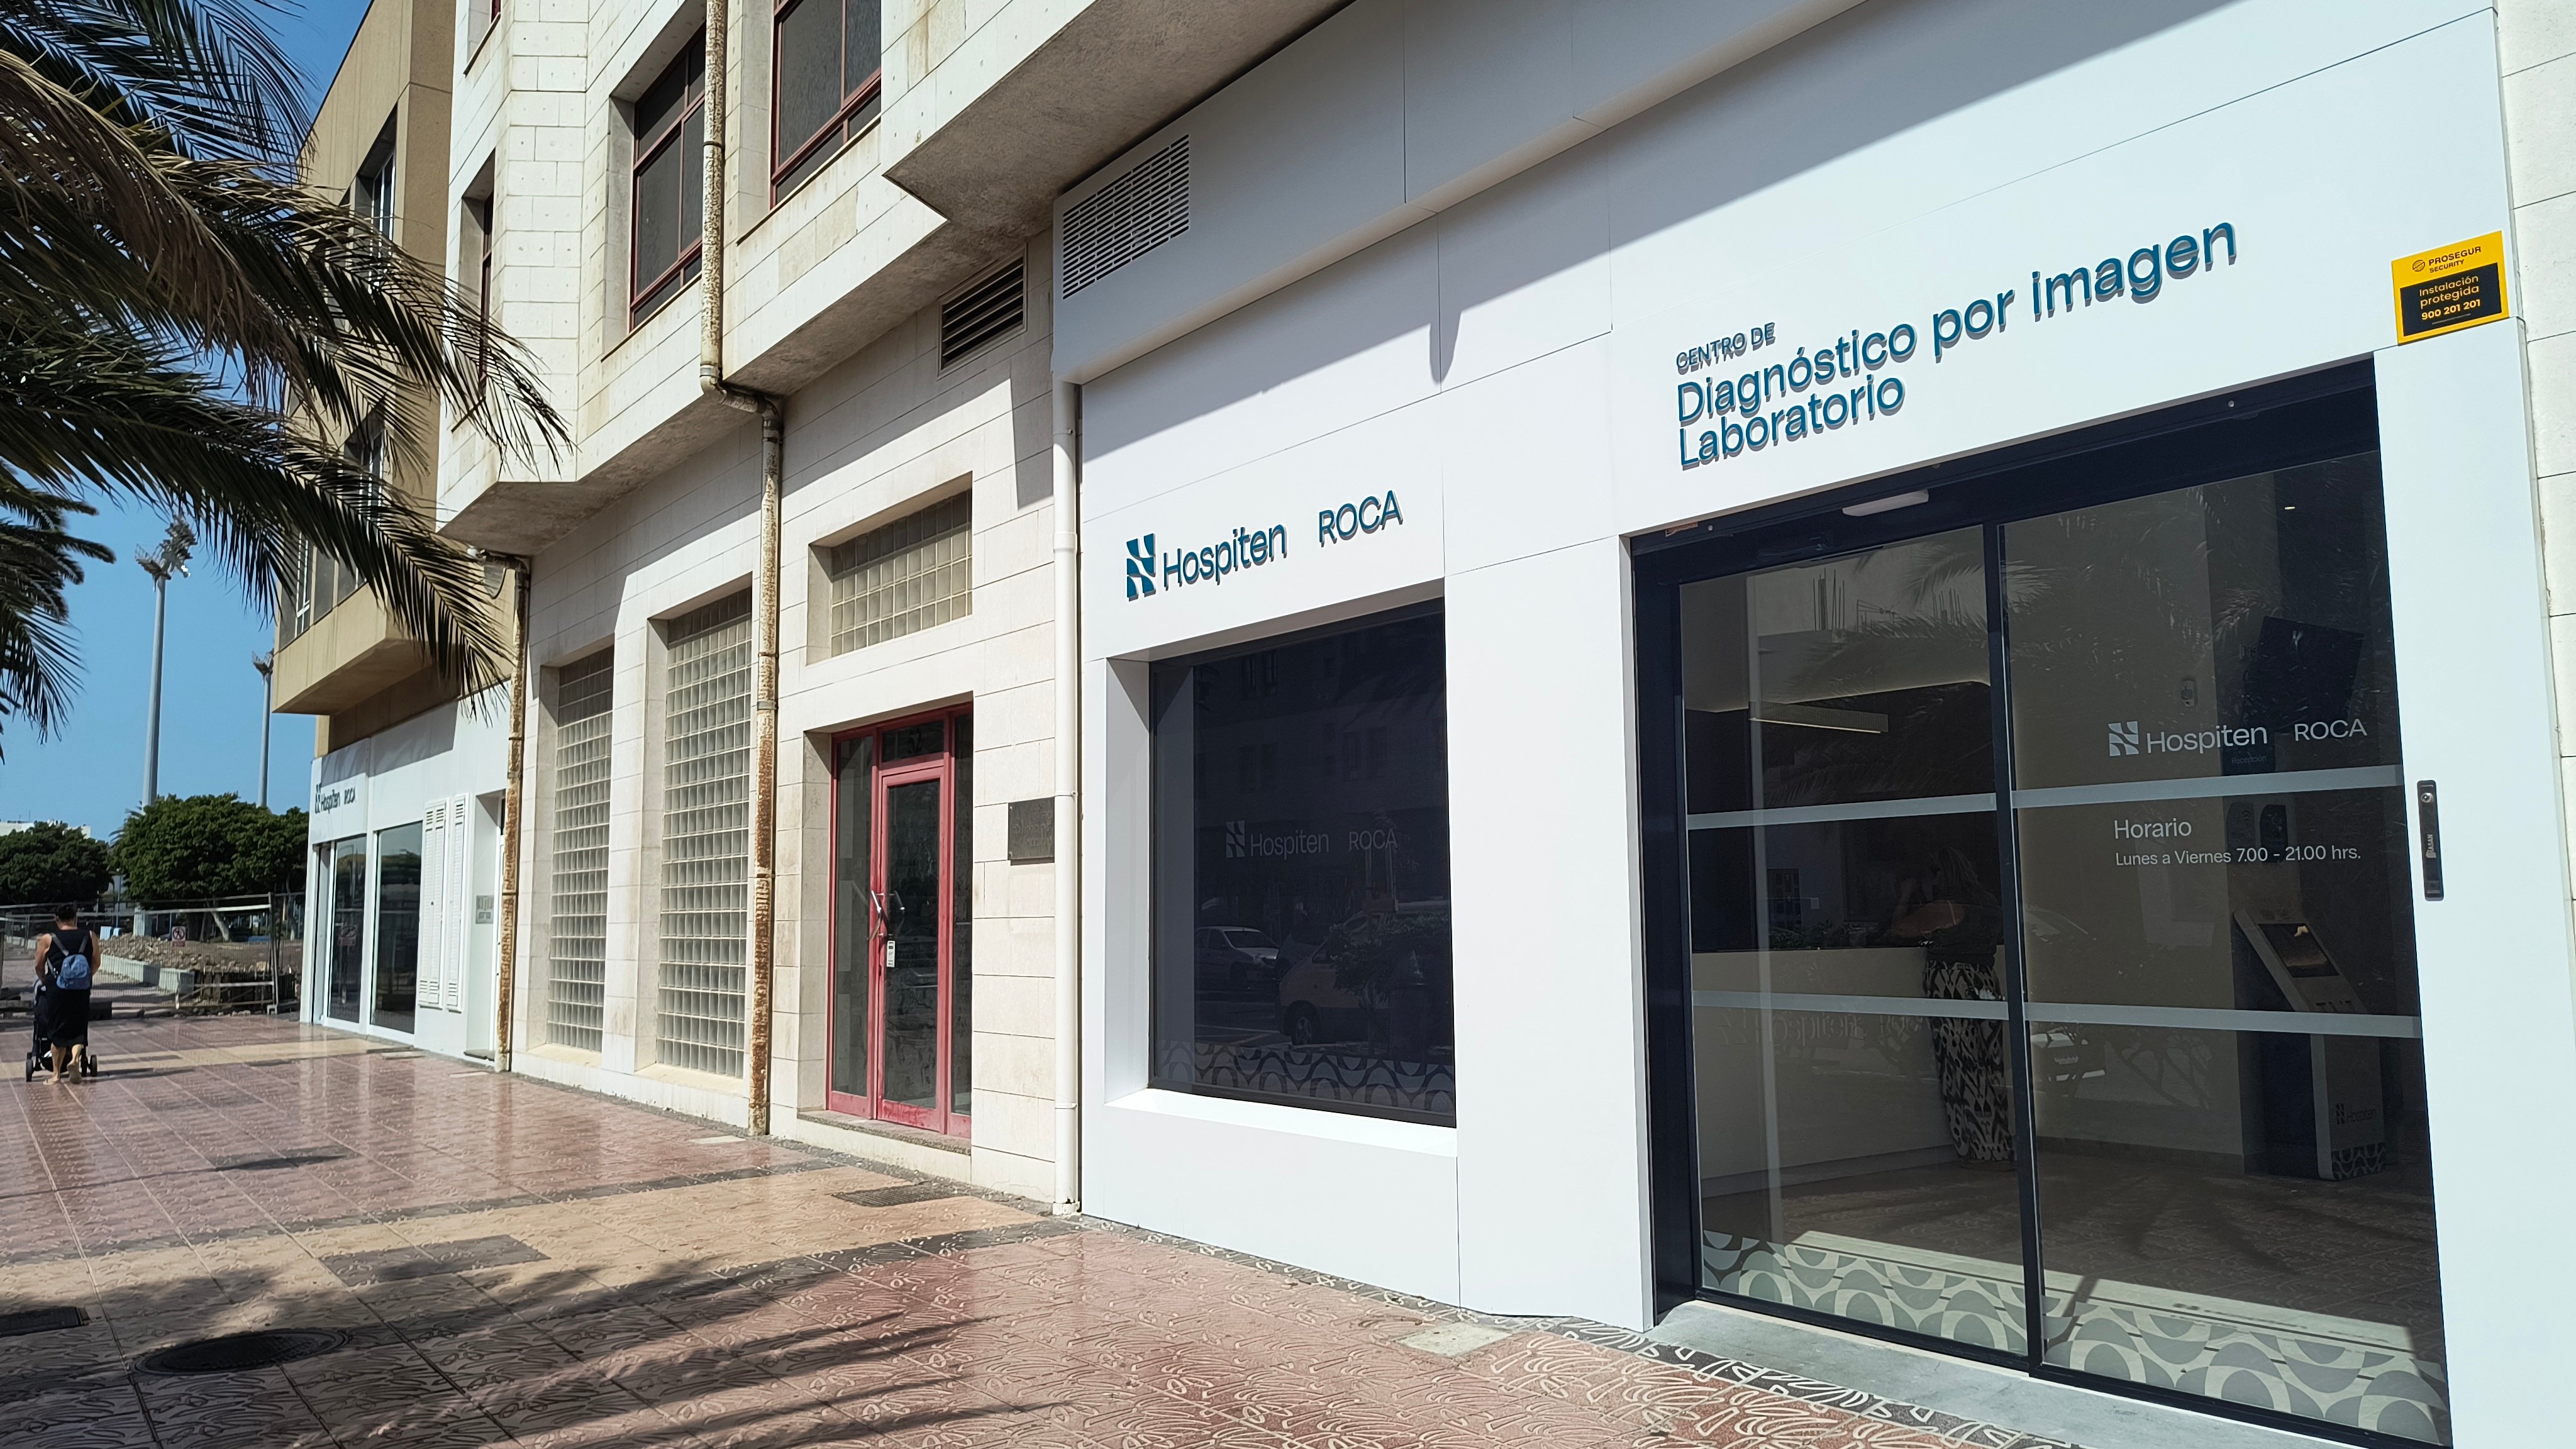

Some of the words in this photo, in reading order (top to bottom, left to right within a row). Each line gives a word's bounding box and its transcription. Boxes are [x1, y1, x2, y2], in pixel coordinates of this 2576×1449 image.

[2429, 246, 2482, 266] PROSEGUR
[2429, 259, 2465, 273] SECURITY
[2419, 275, 2479, 297] Instalación
[2420, 286, 2479, 309] protegida
[2421, 309, 2441, 320] 900
[2443, 304, 2461, 315] 201
[2463, 299, 2480, 310] 201
[1678, 323, 1916, 424] Diagnóstico
[1933, 289, 2014, 359] por
[2032, 222, 2235, 316] imagen
[1676, 332, 1746, 371] CENTRO
[1751, 321, 1775, 347] DE
[1679, 374, 1904, 467] Laboratorio
[1163, 523, 1286, 589] Hospiten
[1319, 489, 1402, 545] ROCA
[2146, 724, 2268, 754] Hospiten
[2294, 718, 2368, 741] ROCA
[2114, 818, 2192, 839] Horario
[1250, 829, 1330, 860] Hospiten
[1348, 828, 1398, 852] ROCA
[2116, 852, 2158, 866] Lunes
[2162, 855, 2171, 865] a
[2175, 850, 2232, 865] Viernes
[2236, 847, 2268, 863] 7.00
[2285, 845, 2327, 862] 21.00
[2331, 845, 2362, 860] hrs.
